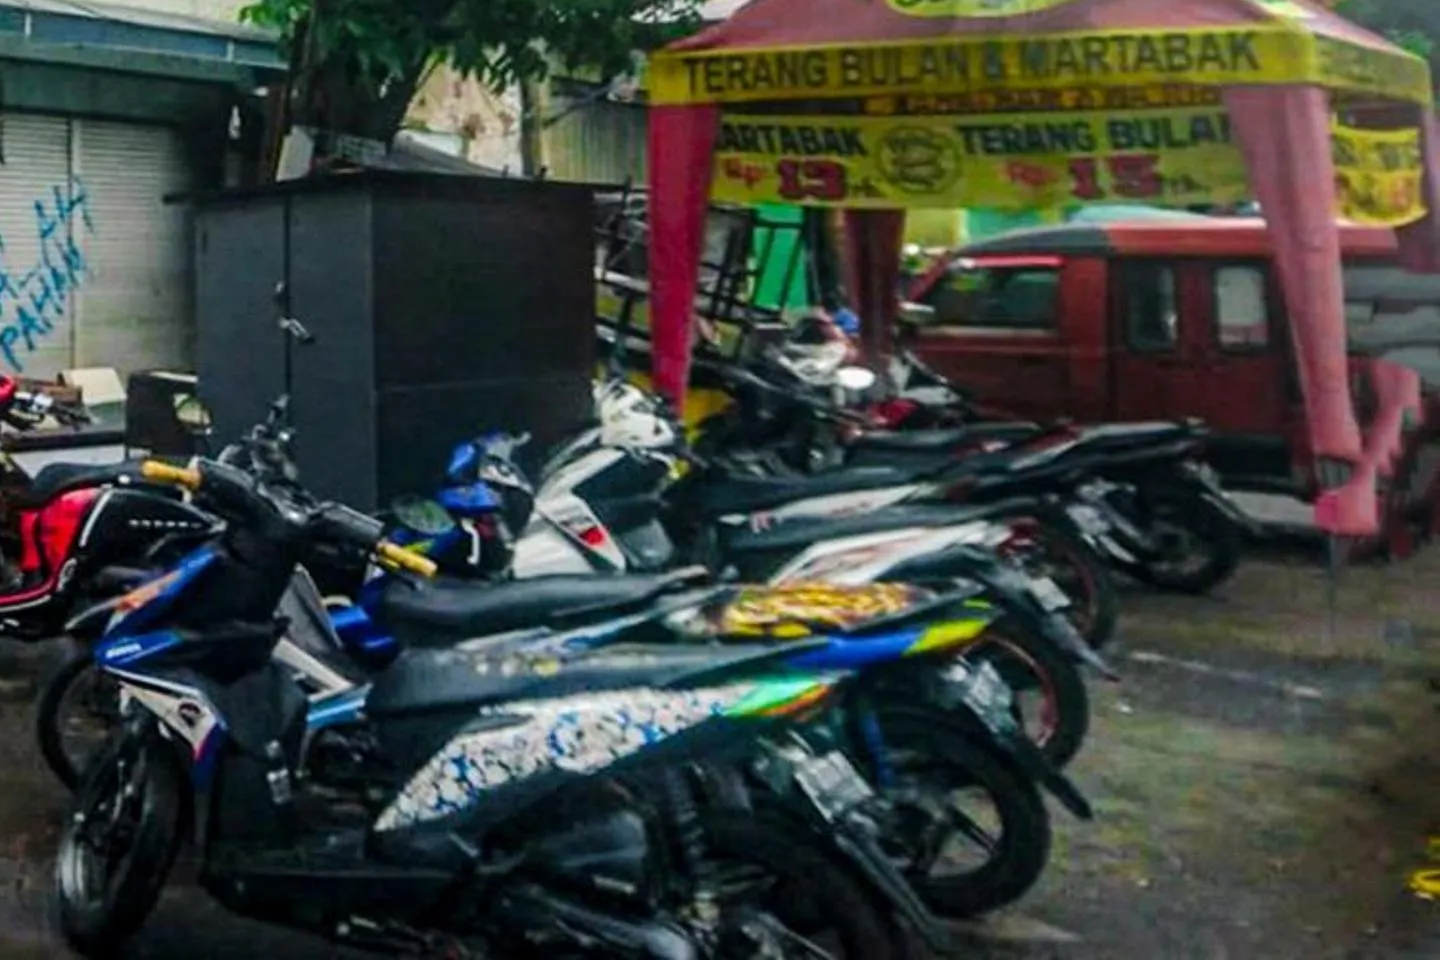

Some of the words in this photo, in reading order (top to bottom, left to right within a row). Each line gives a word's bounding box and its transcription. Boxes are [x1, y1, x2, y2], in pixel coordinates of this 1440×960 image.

[682, 49, 828, 94] TERANG
[840, 42, 970, 87] BULAN
[984, 39, 1003, 80] &
[1020, 31, 1259, 79] MARTABAK
[718, 122, 868, 156] ARTABAK
[955, 120, 1096, 155] TERANG
